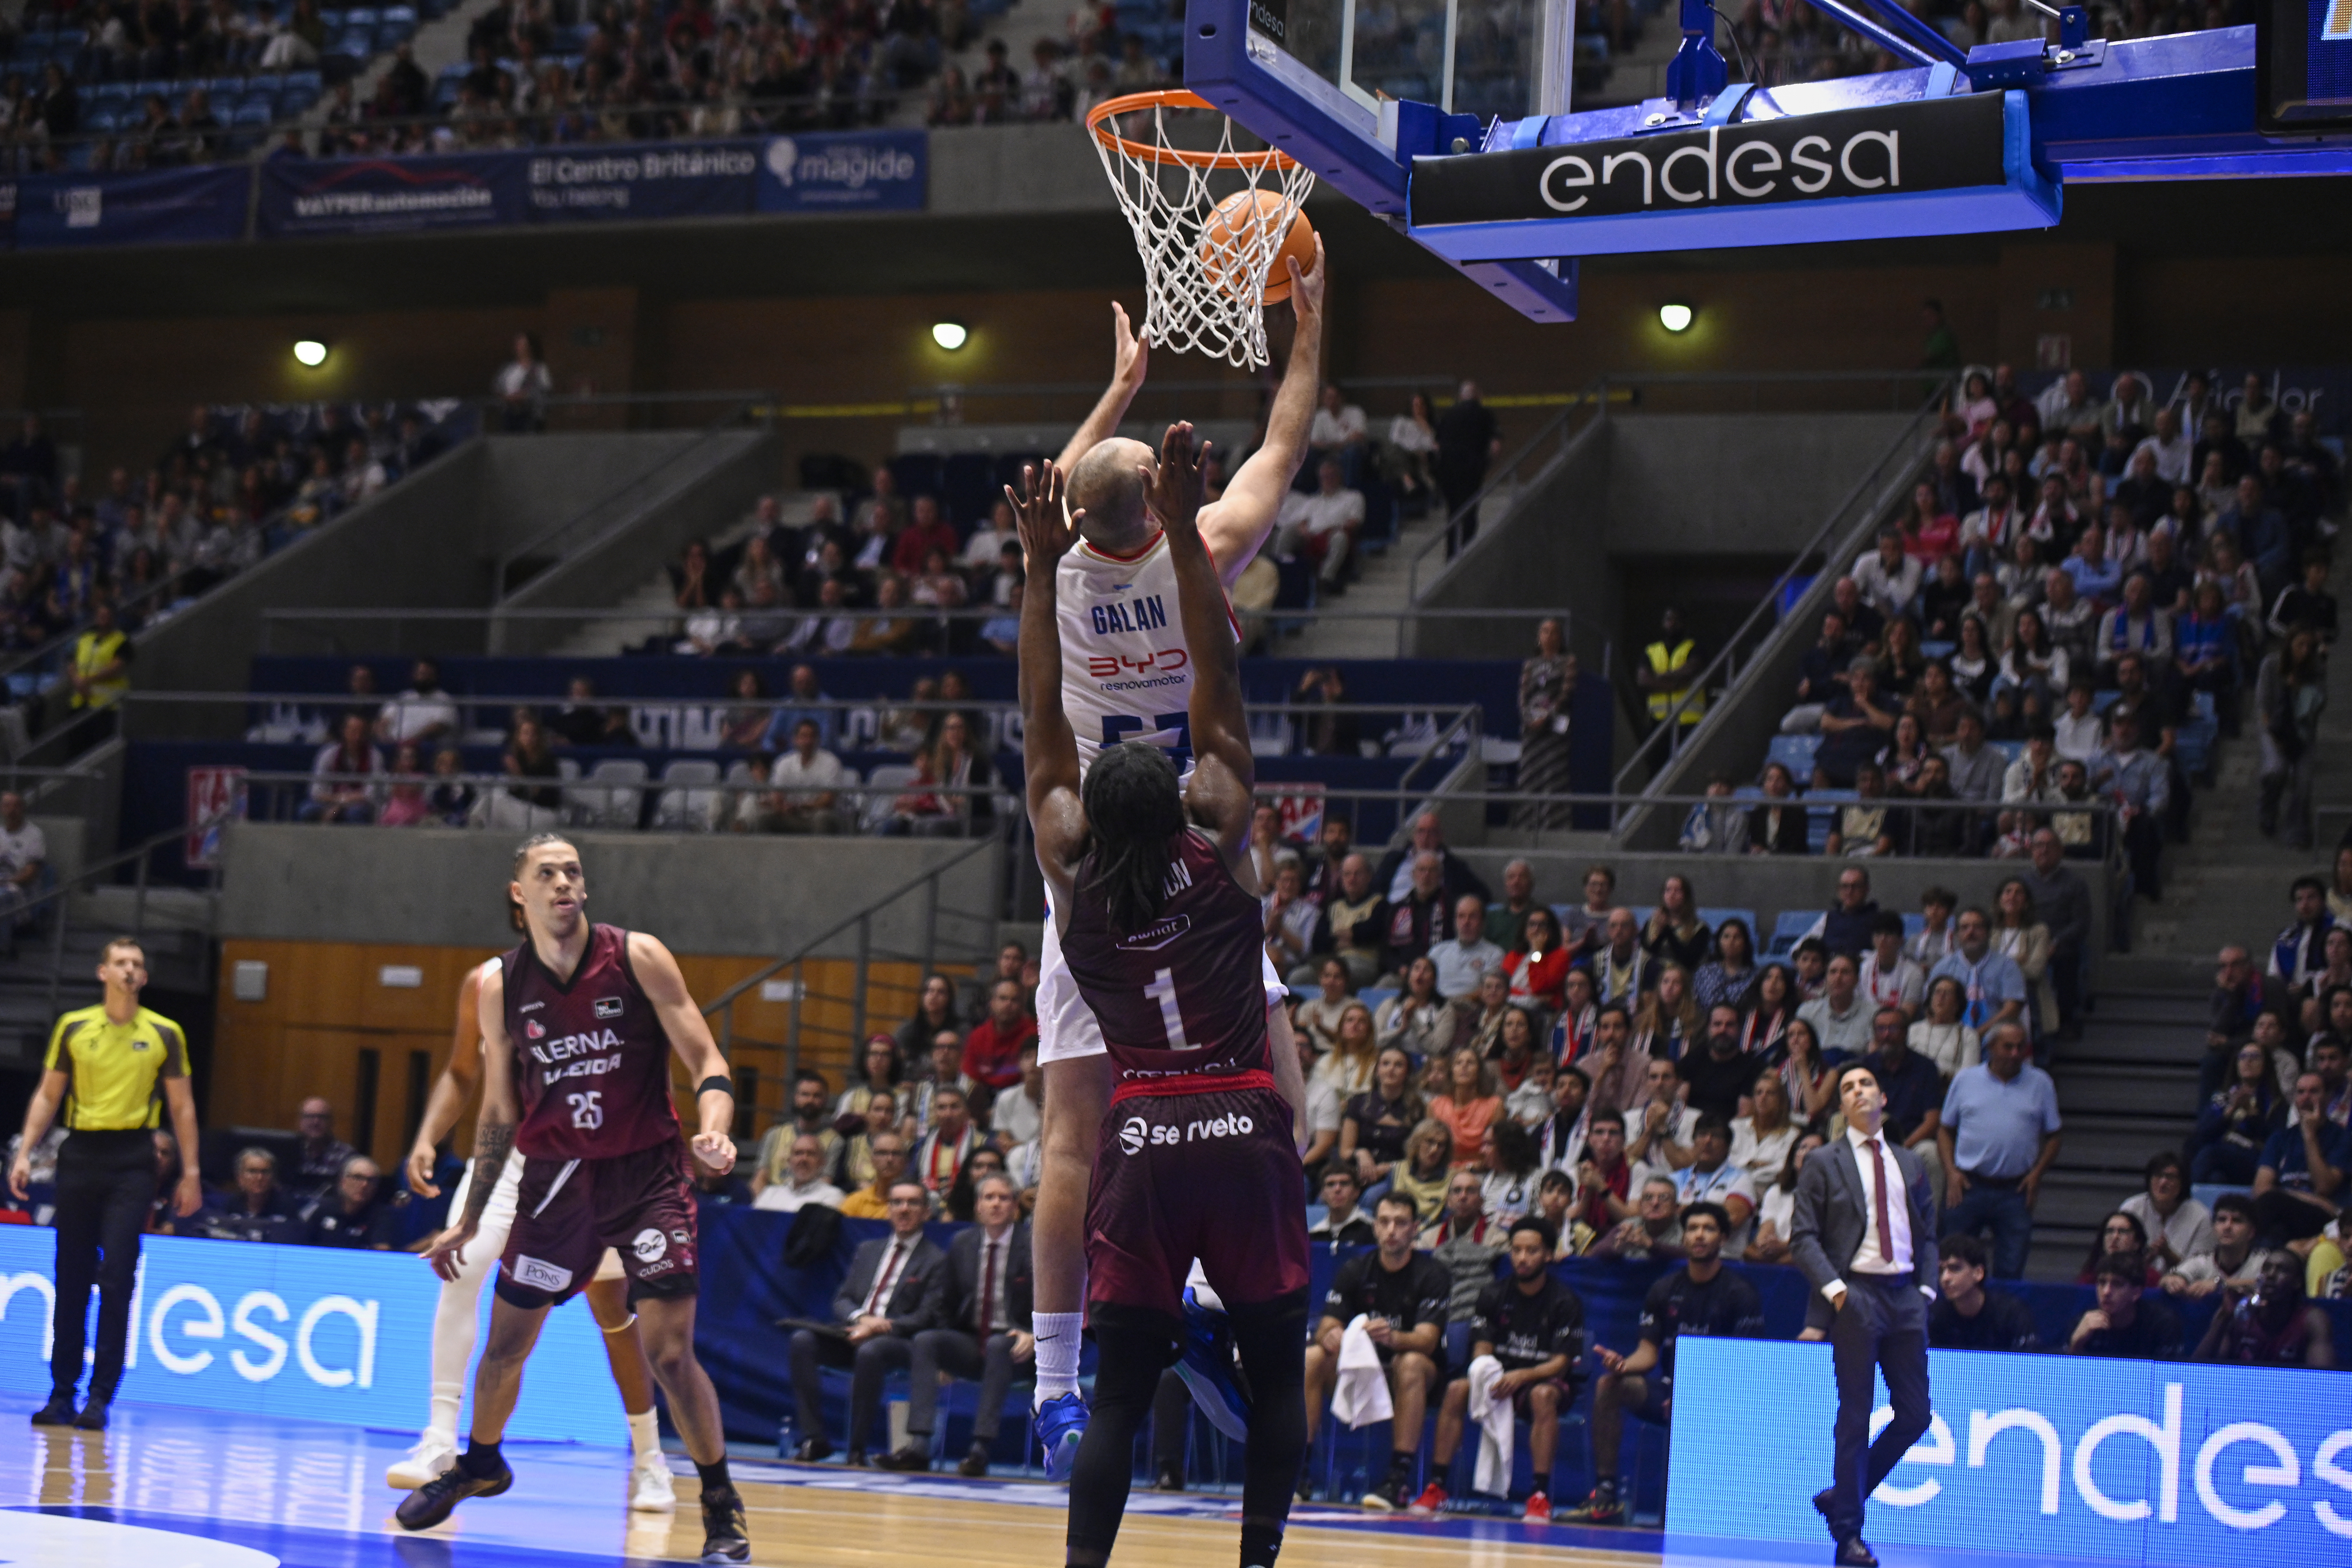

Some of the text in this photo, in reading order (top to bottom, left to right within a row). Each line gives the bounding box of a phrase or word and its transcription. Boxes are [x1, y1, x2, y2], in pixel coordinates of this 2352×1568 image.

[1251, 1, 1284, 37] ndesa
[1540, 125, 1899, 212] endesa
[1091, 594, 1167, 636] GALAN
[1088, 648, 1188, 677] BYD
[1100, 674, 1187, 691] resnovamotor
[1143, 967, 1202, 1051] 1
[566, 1090, 604, 1130] 25
[524, 1264, 560, 1286] PONS
[0, 1253, 379, 1388] nesa
[1866, 1382, 2352, 1539] endes
